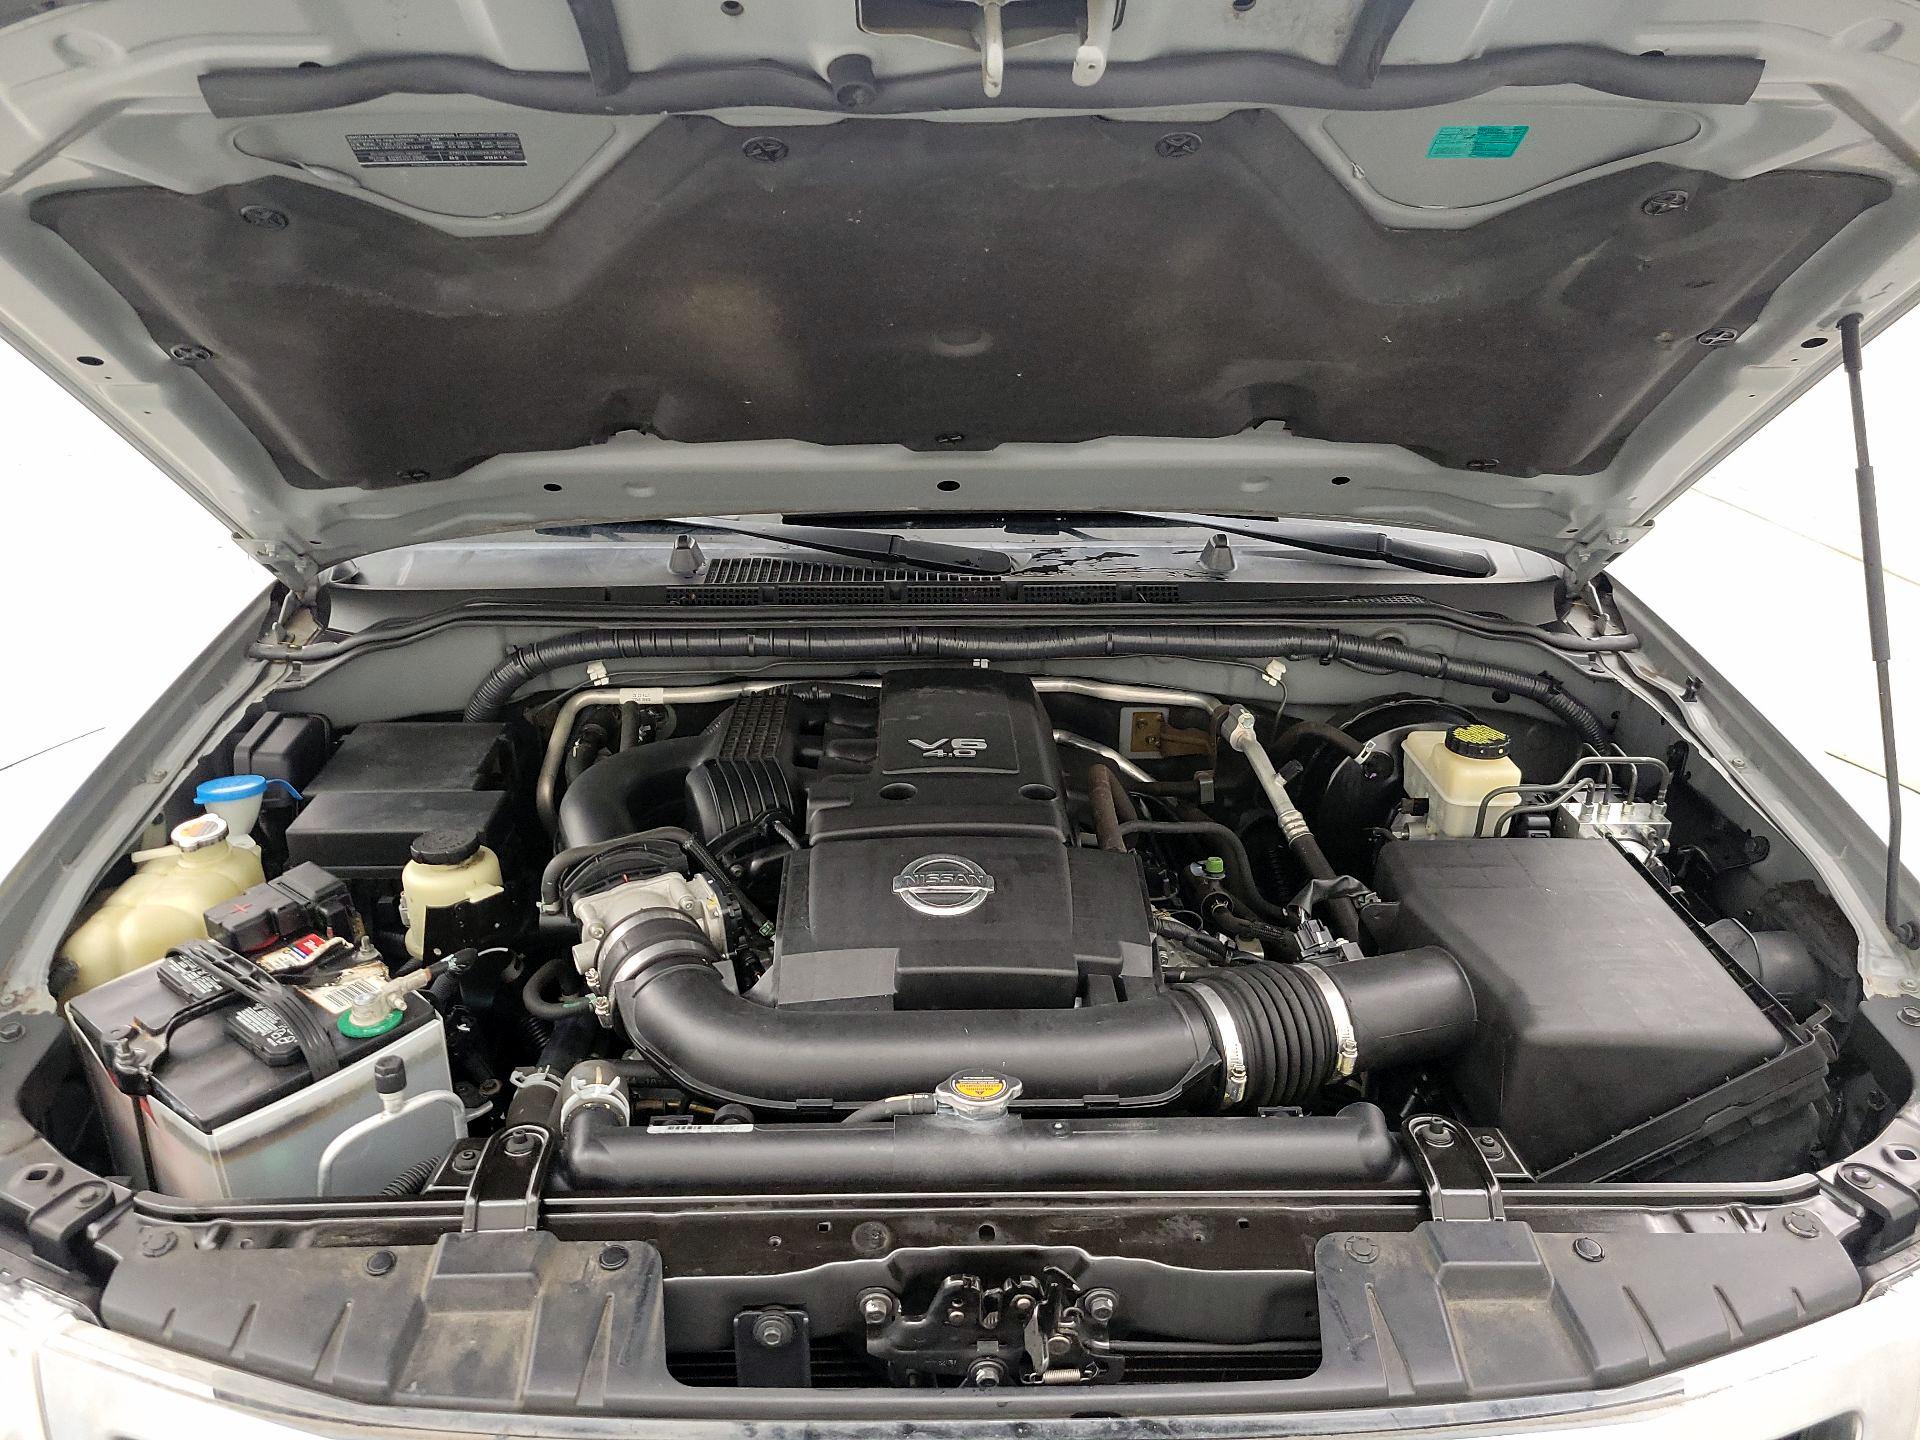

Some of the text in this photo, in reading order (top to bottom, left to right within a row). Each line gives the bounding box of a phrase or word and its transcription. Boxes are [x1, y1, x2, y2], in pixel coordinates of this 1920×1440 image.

[908, 738, 987, 750] V6
[923, 749, 977, 758] 4.0
[904, 874, 984, 885] NISSAN
